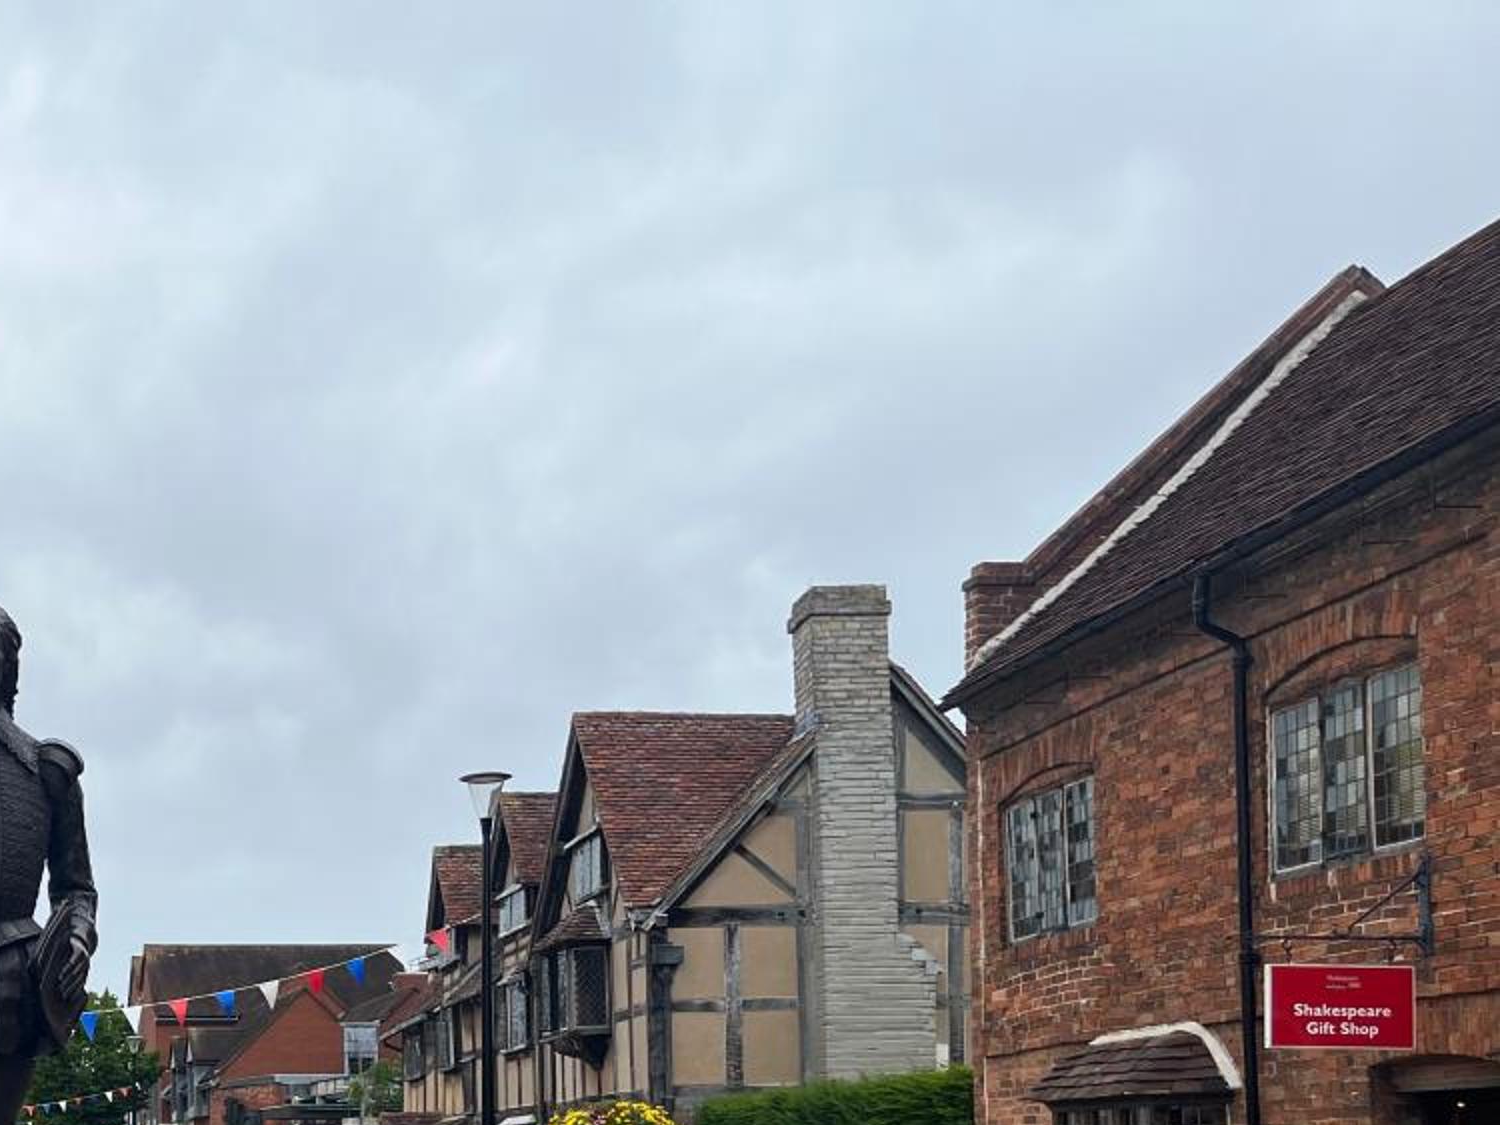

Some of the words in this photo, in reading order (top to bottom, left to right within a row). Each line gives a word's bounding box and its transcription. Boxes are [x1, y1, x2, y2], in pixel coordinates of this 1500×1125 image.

[1293, 1003, 1392, 1020] Shakespeare
[1305, 1021, 1335, 1035] Gift
[1339, 1021, 1379, 1039] Shop
